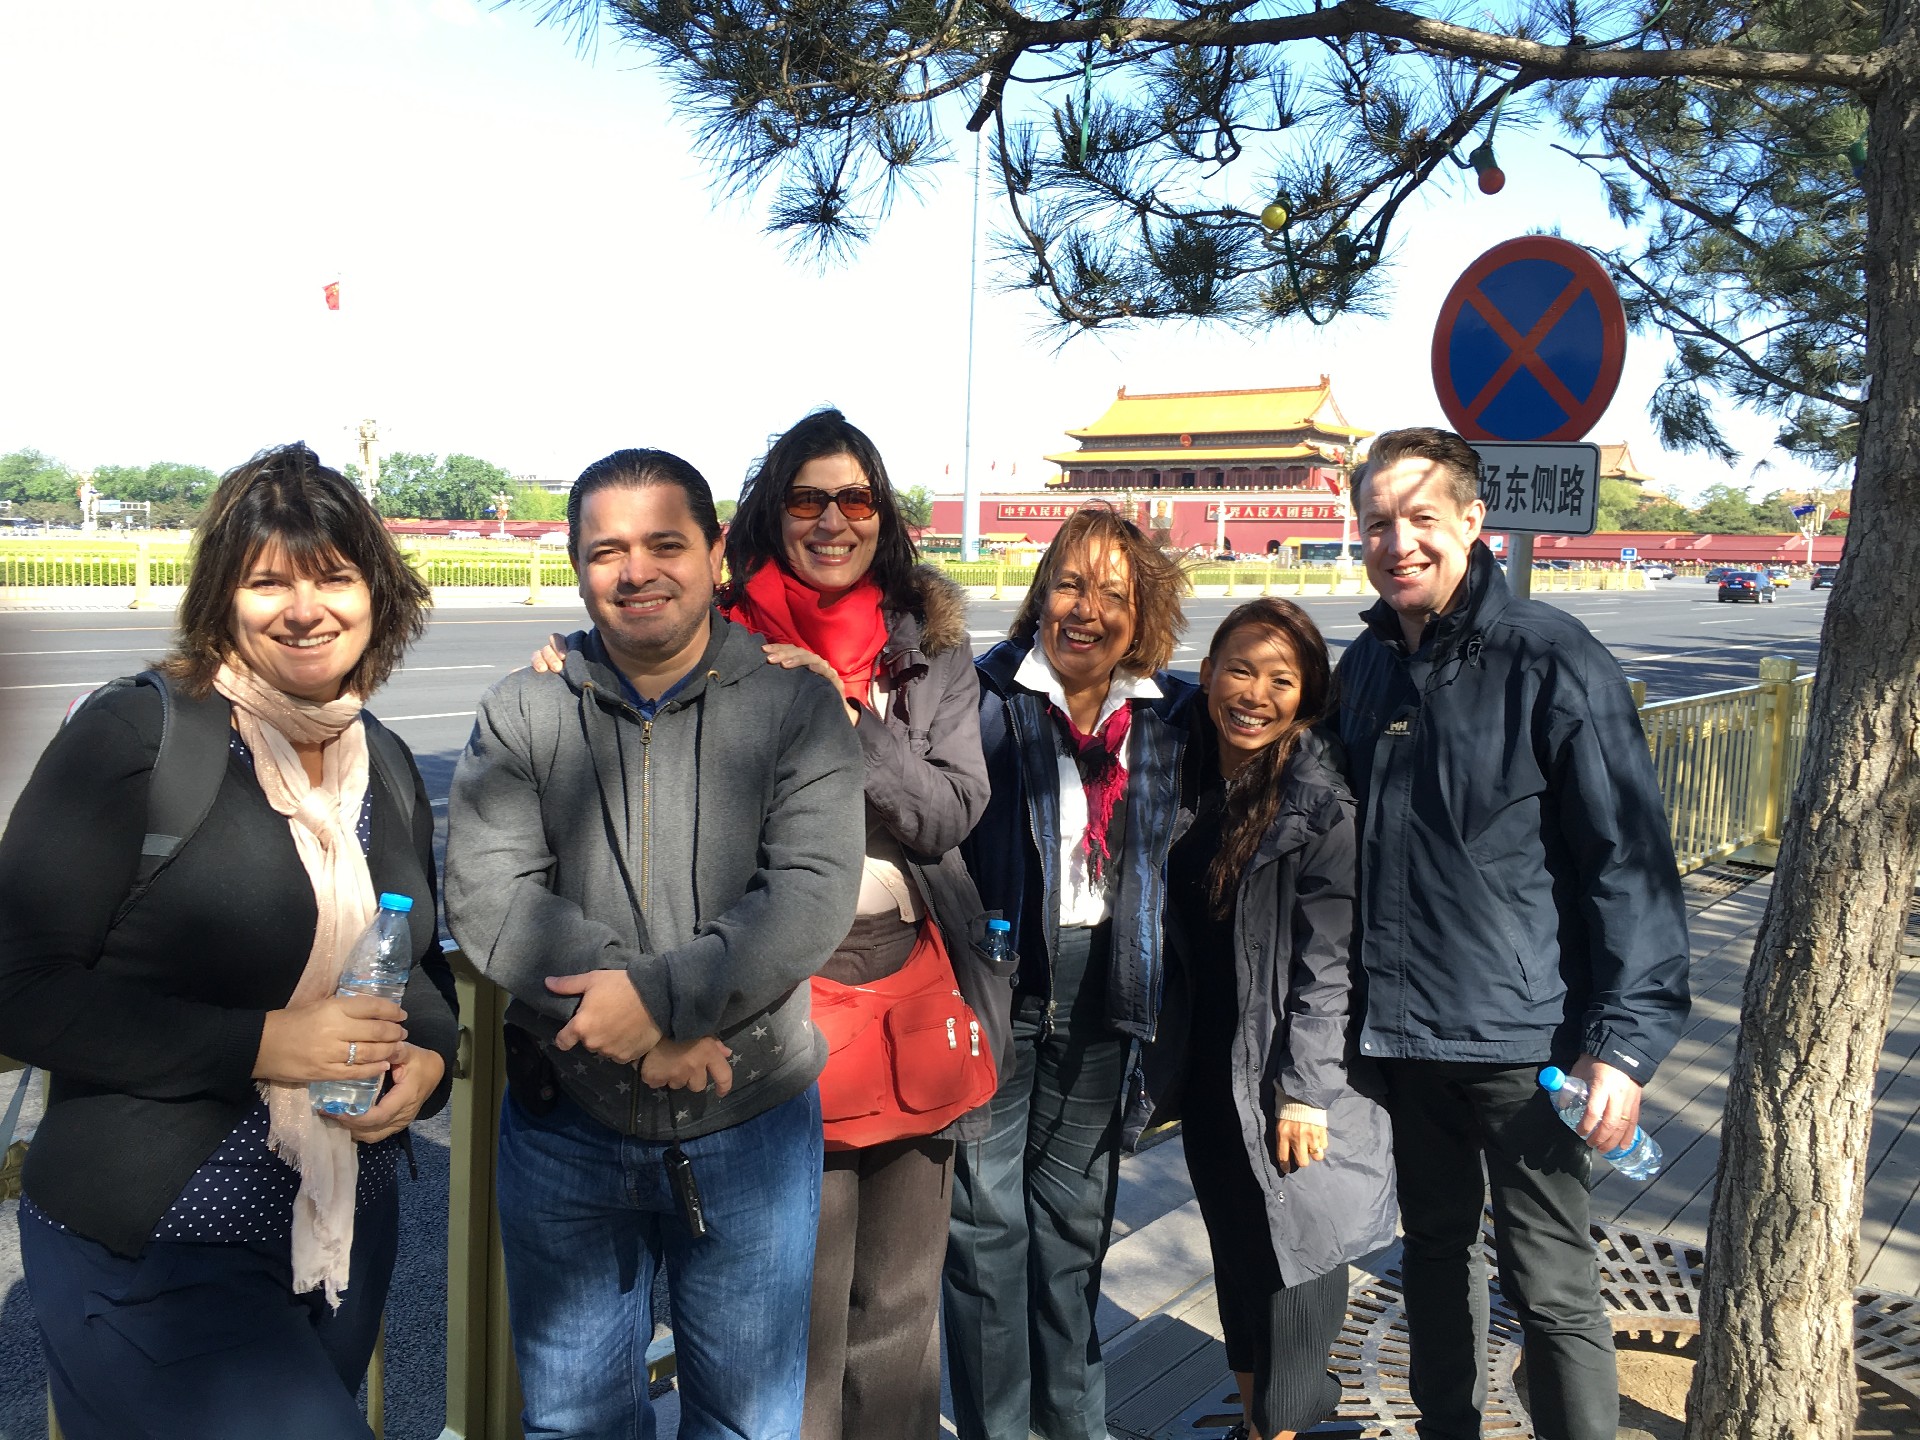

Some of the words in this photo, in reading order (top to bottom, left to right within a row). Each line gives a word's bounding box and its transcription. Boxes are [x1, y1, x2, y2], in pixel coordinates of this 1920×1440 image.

[1479, 464, 1585, 516] 场东侧路
[1004, 506, 1078, 517] 中华人民共和
